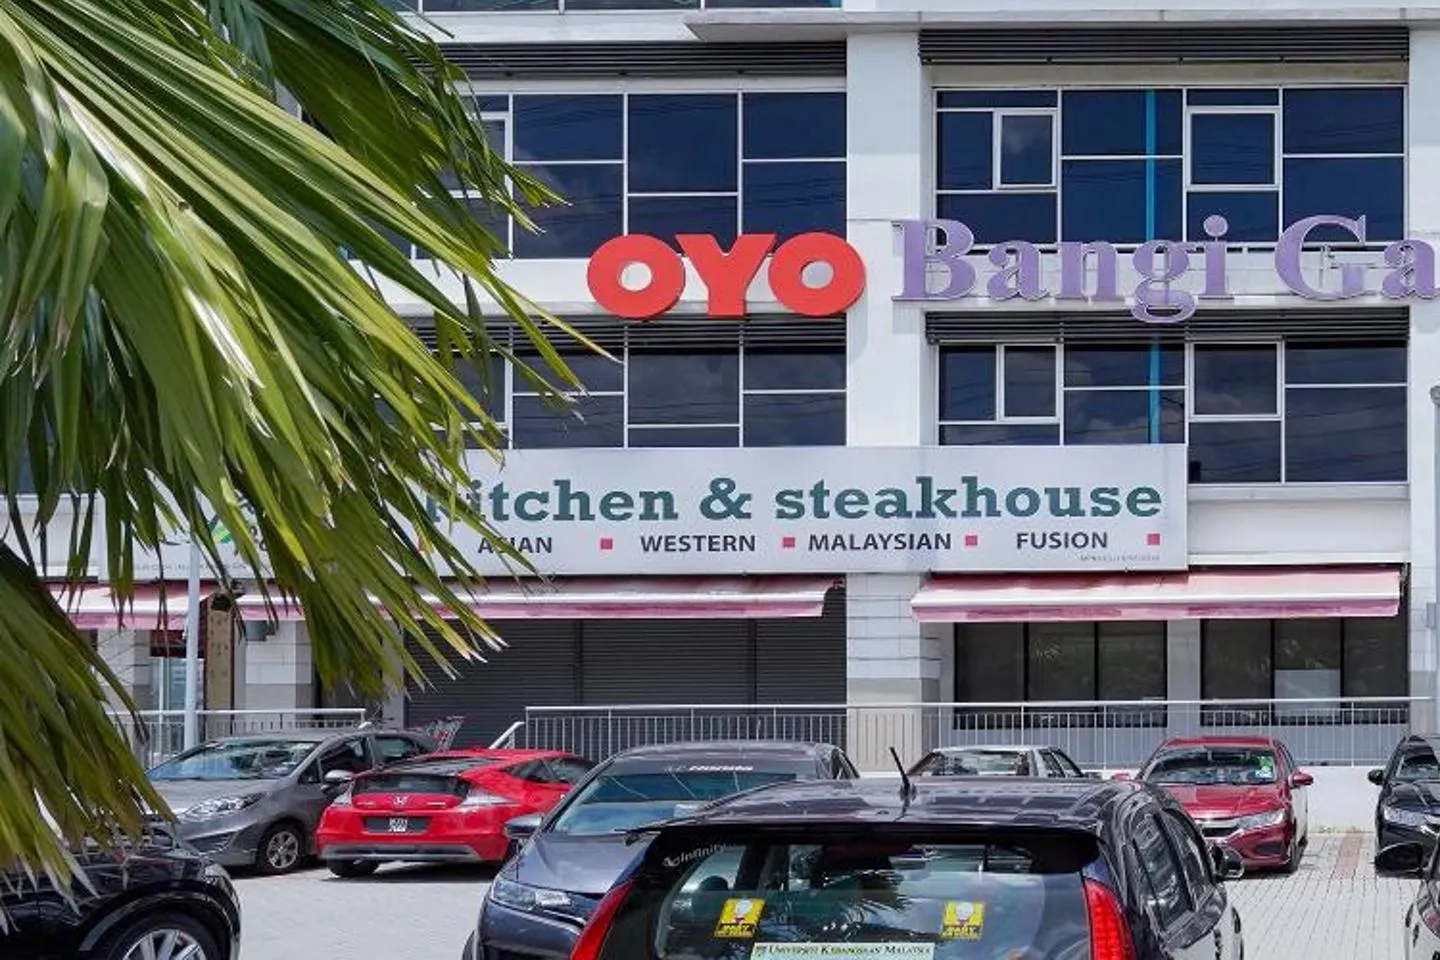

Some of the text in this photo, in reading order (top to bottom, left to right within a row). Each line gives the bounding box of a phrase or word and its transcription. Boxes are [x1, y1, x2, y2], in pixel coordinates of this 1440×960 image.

[586, 233, 867, 319] OYO
[892, 214, 1235, 324] Bangi
[699, 477, 753, 521] &
[775, 475, 1163, 520] steakhouse
[477, 531, 1108, 554] AIAN WESTERN MALAYSIAN FUSION
